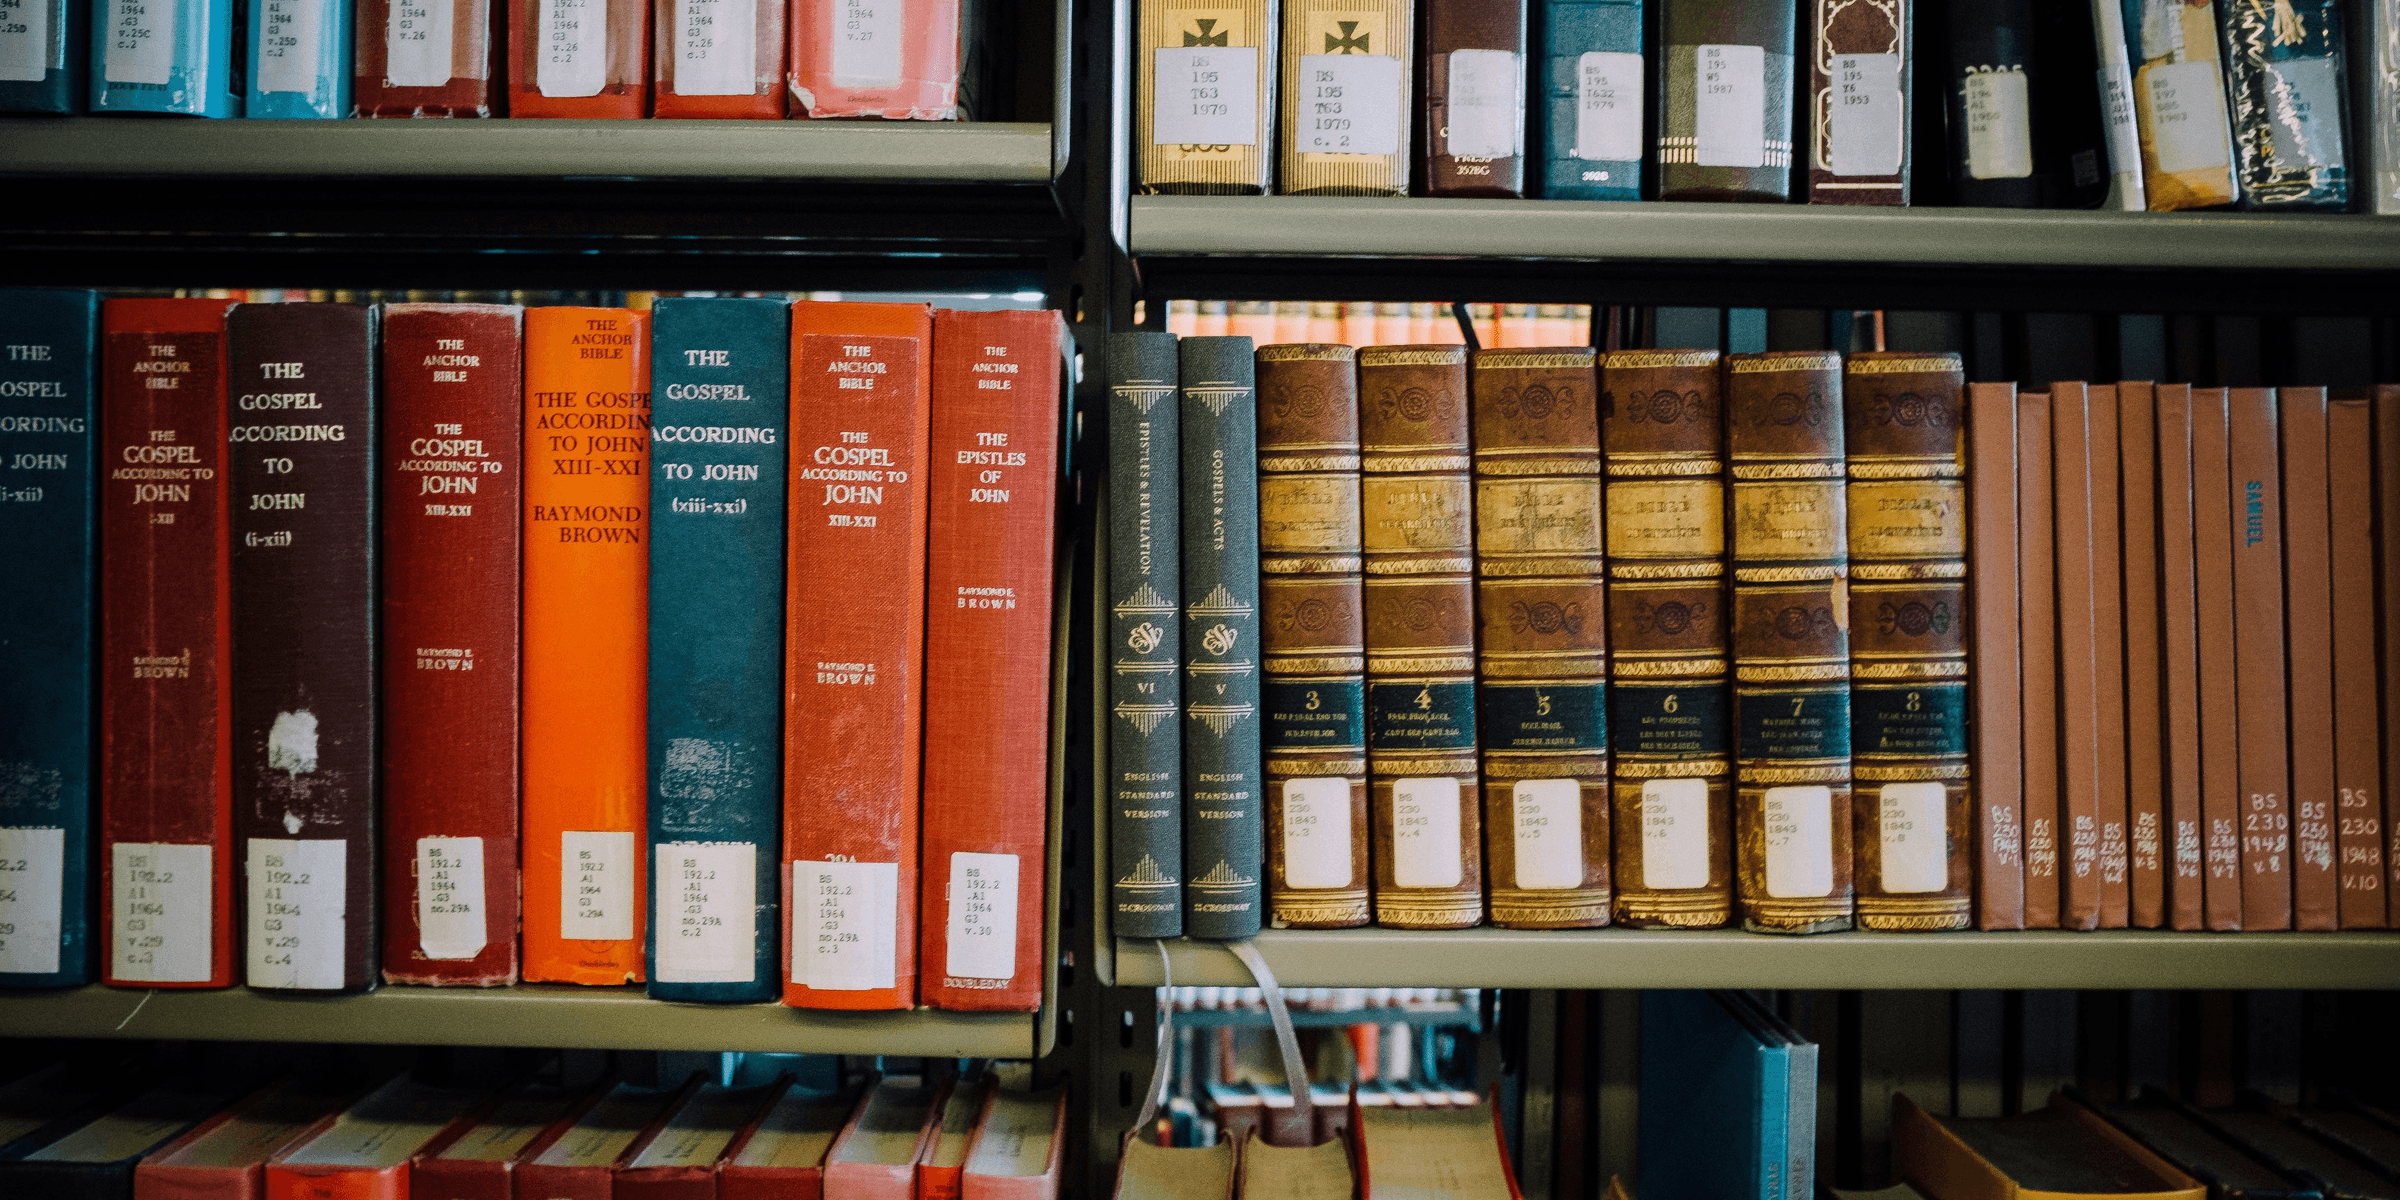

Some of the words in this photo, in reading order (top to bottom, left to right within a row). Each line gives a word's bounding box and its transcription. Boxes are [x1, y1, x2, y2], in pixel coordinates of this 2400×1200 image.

[120, 6, 144, 15] 1964
[401, 9, 426, 17] 1964
[849, 10, 873, 18] 1964
[269, 15, 292, 24] 1964
[689, 17, 713, 26] 1964
[553, 21, 578, 30] 1964
[848, 21, 860, 30] G3
[400, 31, 426, 40] v.26
[552, 32, 566, 41] G3
[688, 28, 700, 37] G3
[848, 32, 873, 41] v.27
[118, 40, 137, 49] c.2
[553, 43, 578, 52] v.26
[688, 39, 713, 48] v.26
[553, 55, 572, 63] c.2
[1707, 61, 1726, 69] 195
[1192, 71, 1218, 82] 195
[1192, 87, 1218, 98] T63
[1316, 87, 1342, 98] 195
[1193, 104, 1228, 115] 1979
[1315, 103, 1342, 114] T63
[1586, 101, 1615, 109] 1979
[1315, 119, 1351, 130] 1979
[587, 320, 618, 331] THE
[437, 339, 464, 350] THE
[572, 334, 632, 345] ANCHOR
[7, 345, 51, 361] THE
[149, 345, 176, 357] THE
[580, 348, 623, 359] BIBLE
[843, 345, 871, 357] THE
[985, 346, 1007, 356] THE
[423, 355, 480, 367] ANCHOR
[684, 350, 729, 366] THE
[133, 362, 191, 373] ANCHOR
[260, 363, 304, 379] THE
[827, 362, 887, 374] ANCHOR
[972, 363, 1018, 374] ANCHOR
[434, 371, 467, 382] BIBLE
[146, 378, 179, 390] BIBLE
[839, 378, 873, 390] BIBLE
[979, 379, 1011, 390] BIBLE
[666, 384, 750, 401] GOSPEL
[240, 393, 322, 410] GOSPEL
[535, 392, 577, 408] THE
[229, 425, 345, 443] CCORDING
[435, 424, 462, 435] THE
[149, 431, 175, 441] THE
[840, 432, 868, 444] THE
[976, 433, 1008, 446] THE
[411, 438, 489, 457] GOSPEL
[549, 436, 577, 452] TO
[587, 437, 644, 455] JOHN
[1140, 422, 1150, 478] EPISTLES
[123, 446, 201, 464] GOSPEL
[814, 447, 895, 467] GOSPEL
[957, 451, 1026, 465] EPISTLES
[11, 454, 67, 470] JOHN
[263, 459, 293, 474] TO
[399, 460, 476, 472] ACCORDING
[481, 462, 502, 473] TO
[553, 460, 640, 475] XIII-XXI
[112, 469, 190, 480] ACCORDING
[193, 469, 213, 480] TO
[662, 464, 693, 479] TO
[701, 464, 759, 481] JOHN
[801, 469, 883, 482] ACCORDING
[886, 471, 907, 483] TO
[979, 471, 1002, 483] OF
[1212, 449, 1224, 504] GOSPELS
[420, 476, 478, 495] JOHN
[133, 484, 190, 504] JOHN
[822, 485, 883, 505] JOHN
[969, 489, 1010, 503] JOHN
[250, 494, 305, 510] JOHN
[672, 497, 747, 514] (xiii-xxi)
[534, 506, 641, 522] RAYMOND
[2246, 482, 2263, 547] SAMUEL
[829, 515, 876, 528] XIII-XXI
[246, 531, 292, 547] (i-xii)
[559, 528, 640, 543] BROWN
[1140, 492, 1150, 575] REVELATION
[1213, 518, 1224, 551] ACTS
[958, 599, 1015, 609] BROWN
[417, 659, 474, 670] BROWN
[817, 672, 875, 685] BROWN
[1137, 683, 1155, 693] VI
[1216, 684, 1226, 694] V
[1305, 690, 1320, 710] 3
[1414, 689, 1432, 709] 4
[1663, 694, 1678, 713] 6
[1906, 692, 1920, 711] 8
[1537, 695, 1551, 716] 5
[1791, 698, 1805, 717] 7
[1124, 773, 1170, 781] ENGLISH
[1199, 773, 1243, 781] ENGLISH
[1119, 791, 1174, 800] STANDARD
[1194, 792, 1249, 800] STANDARD
[2341, 788, 2367, 807] BS
[2251, 793, 2277, 811] BS
[1124, 810, 1170, 818] VERSION
[1199, 810, 1244, 819] VERSION
[2300, 801, 2326, 820] BS
[1399, 817, 1428, 825] 1843
[1520, 818, 1548, 826] 1843
[2247, 813, 2288, 831] 230
[1769, 825, 1797, 833] 1843
[2342, 819, 2378, 835] 230
[2244, 834, 2287, 853] 1948
[2342, 847, 2380, 865] 1948
[430, 859, 462, 868] 192.2
[266, 873, 310, 884] 192.2
[683, 870, 715, 880] 192.2
[967, 880, 1000, 889] 192.2
[820, 886, 852, 895] 192.2
[683, 894, 708, 903] 1964
[966, 903, 992, 913] 1964
[820, 909, 845, 919] 1964
[965, 926, 992, 936] v.30
